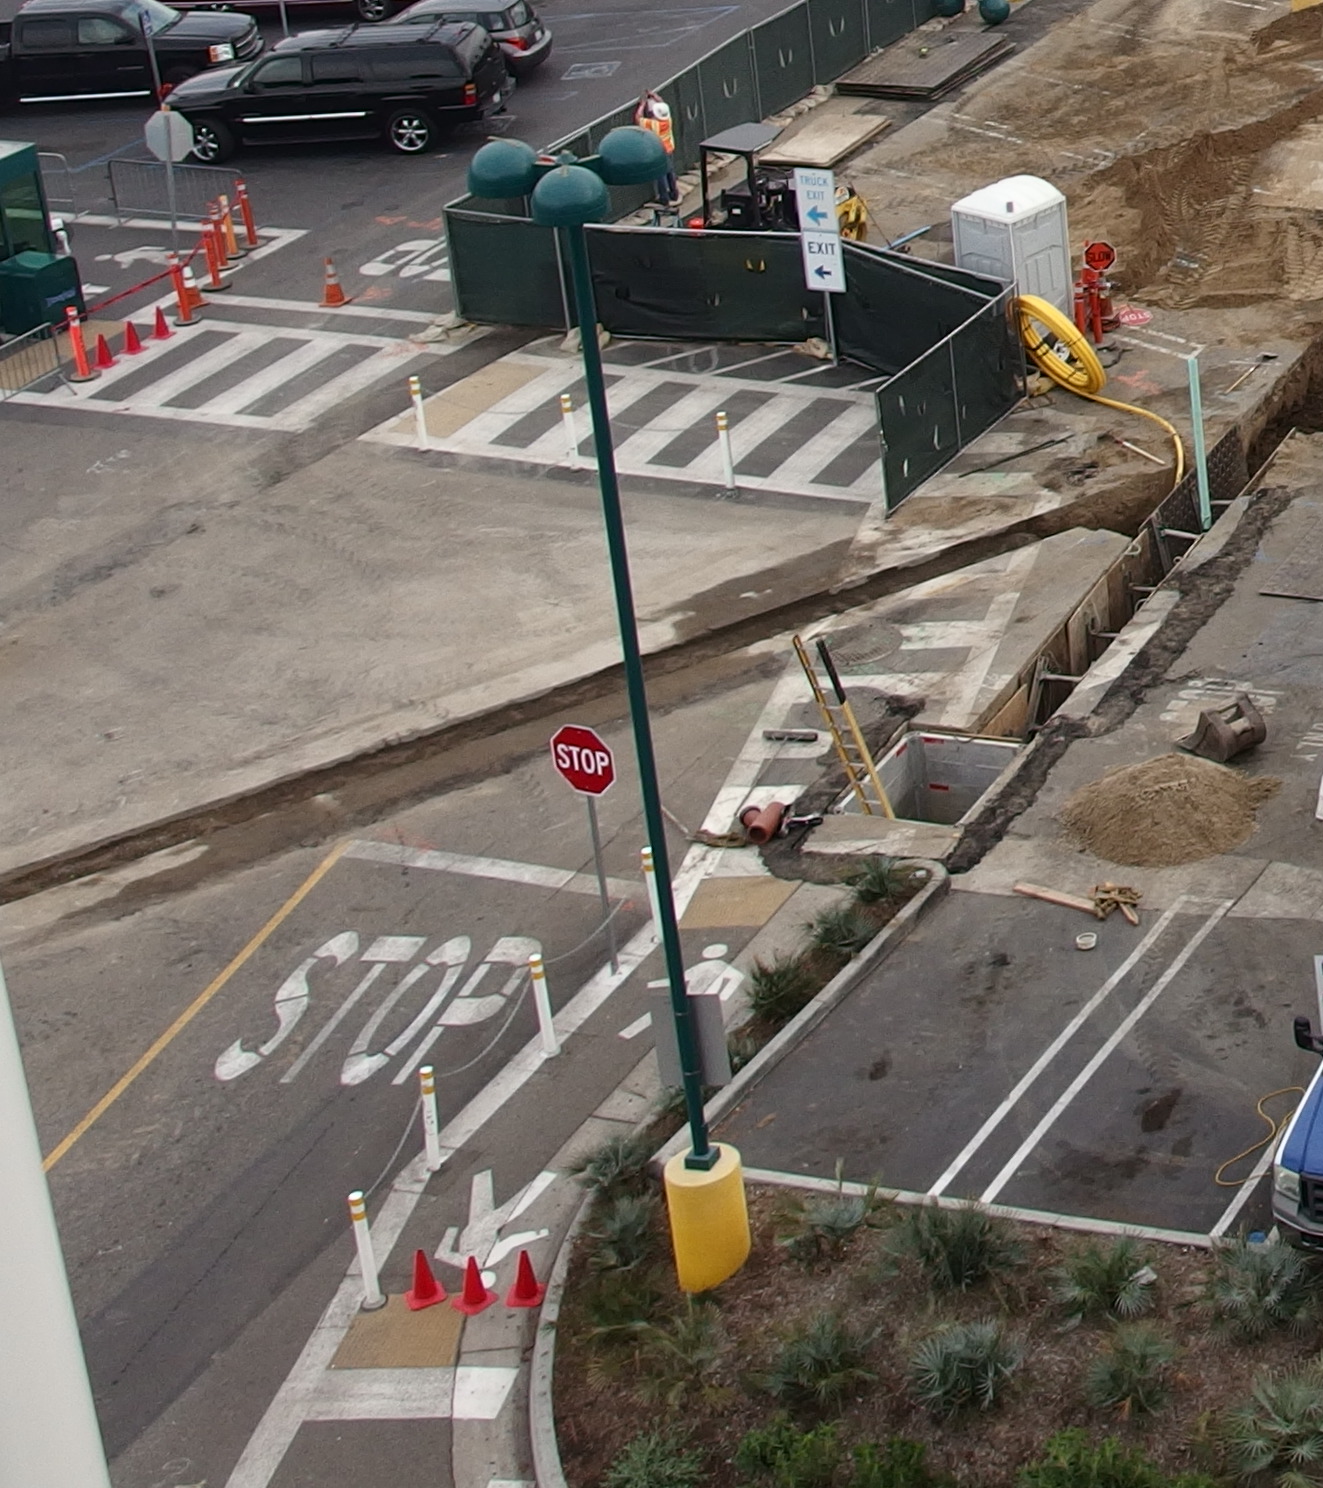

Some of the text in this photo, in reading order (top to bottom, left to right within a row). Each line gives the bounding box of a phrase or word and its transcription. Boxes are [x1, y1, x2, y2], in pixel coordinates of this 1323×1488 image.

[800, 175, 829, 187] TRUCK
[806, 191, 825, 201] EXIT
[807, 241, 836, 255] EXIT
[556, 743, 610, 776] STOP
[214, 930, 542, 1086] STOP
